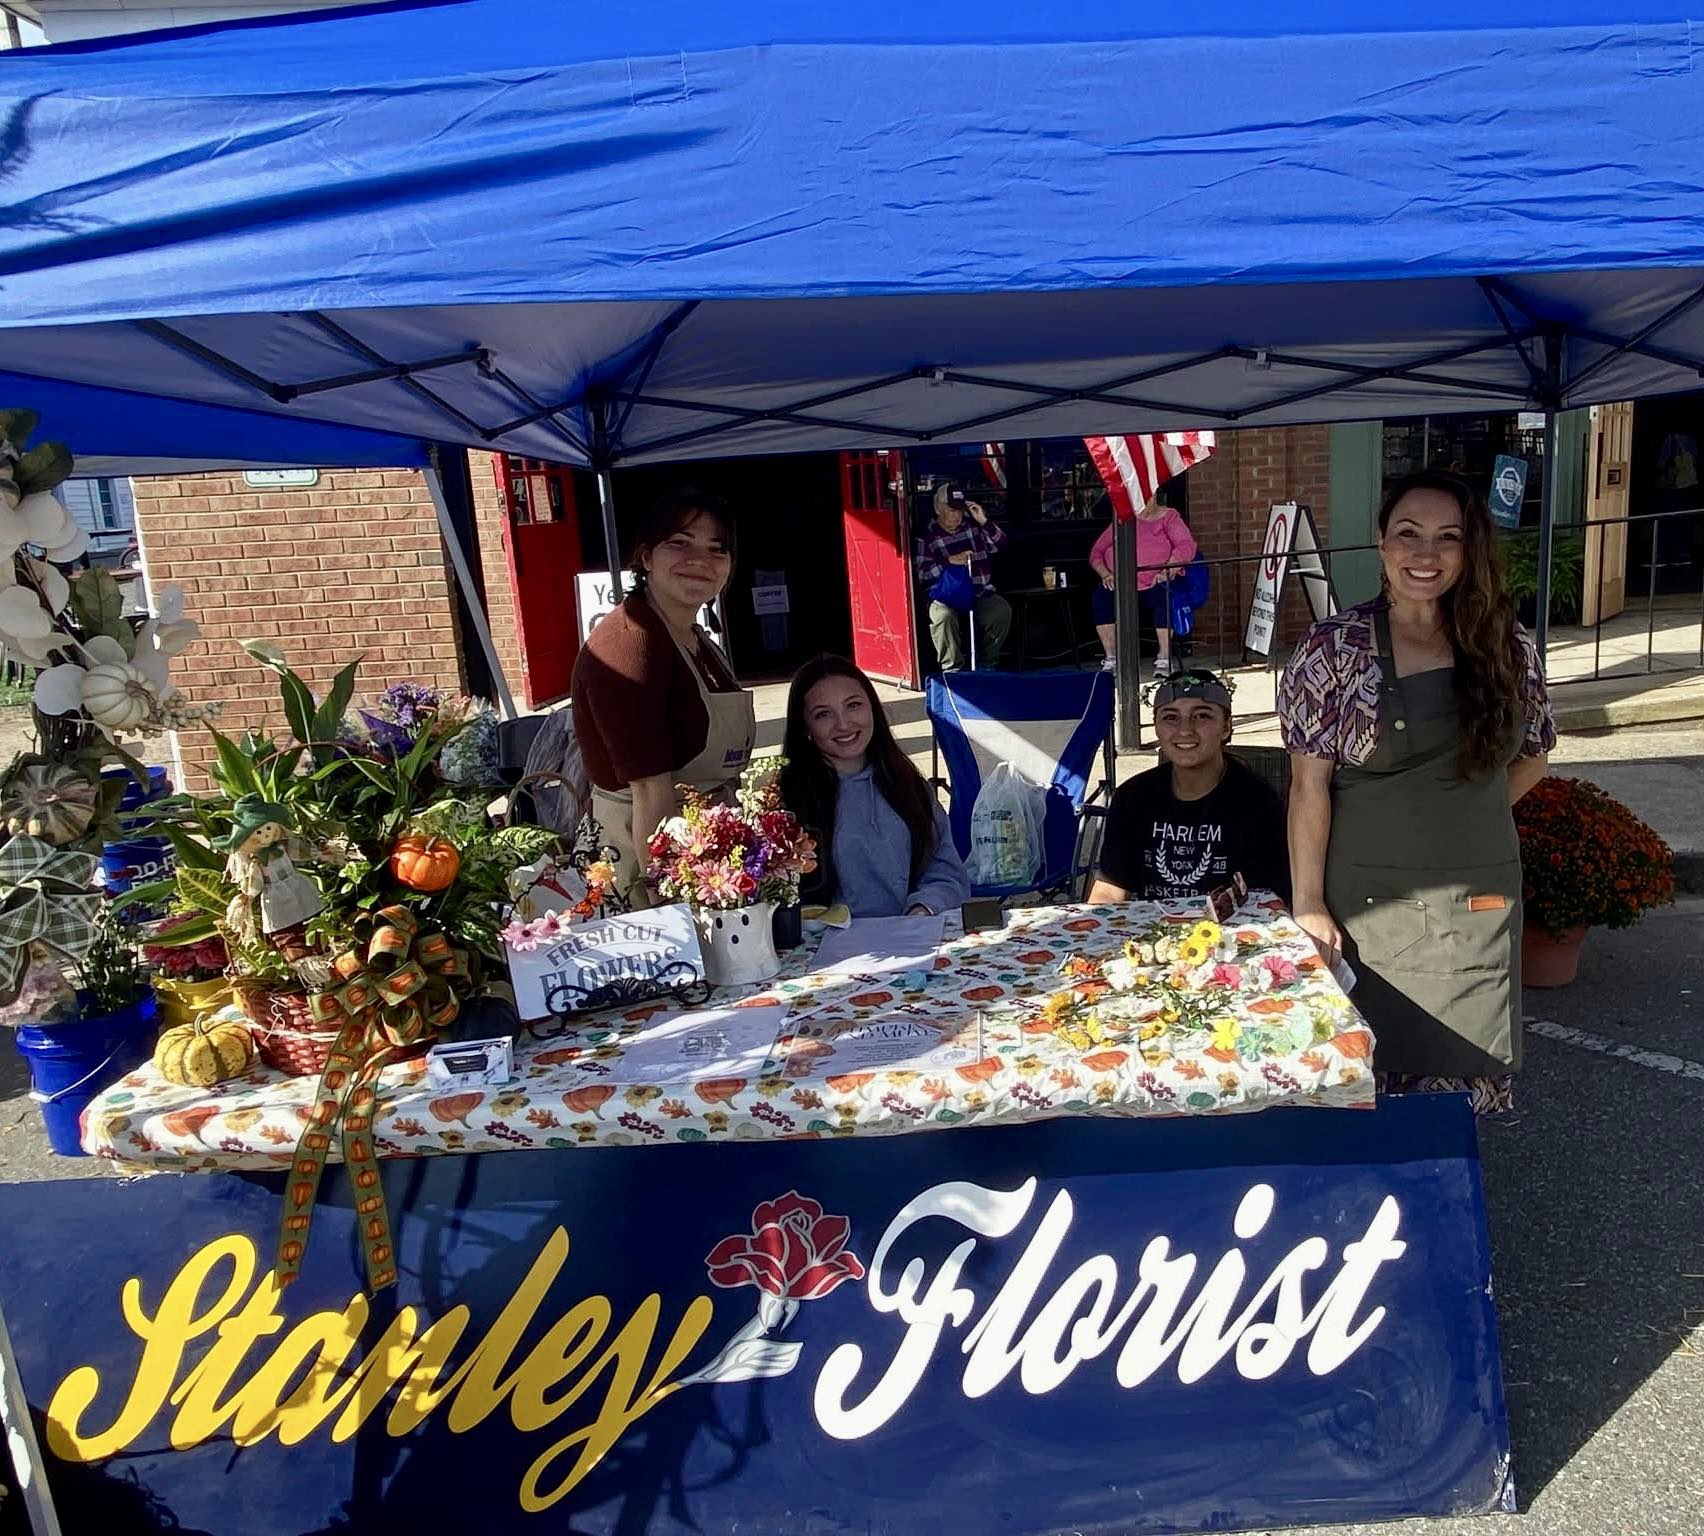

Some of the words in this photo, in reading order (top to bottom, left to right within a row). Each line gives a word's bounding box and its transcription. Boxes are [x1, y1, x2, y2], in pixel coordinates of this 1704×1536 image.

[1152, 821, 1222, 842] HARLEM
[1173, 845, 1195, 856] NEW
[1171, 859, 1194, 870] YORK
[1212, 860, 1227, 870] 48
[546, 926, 616, 968] FRESH
[622, 924, 664, 943] CUT
[538, 945, 684, 1002] FLOWERS
[46, 1225, 712, 1513] Stanley
[814, 1175, 1406, 1440] Florist
